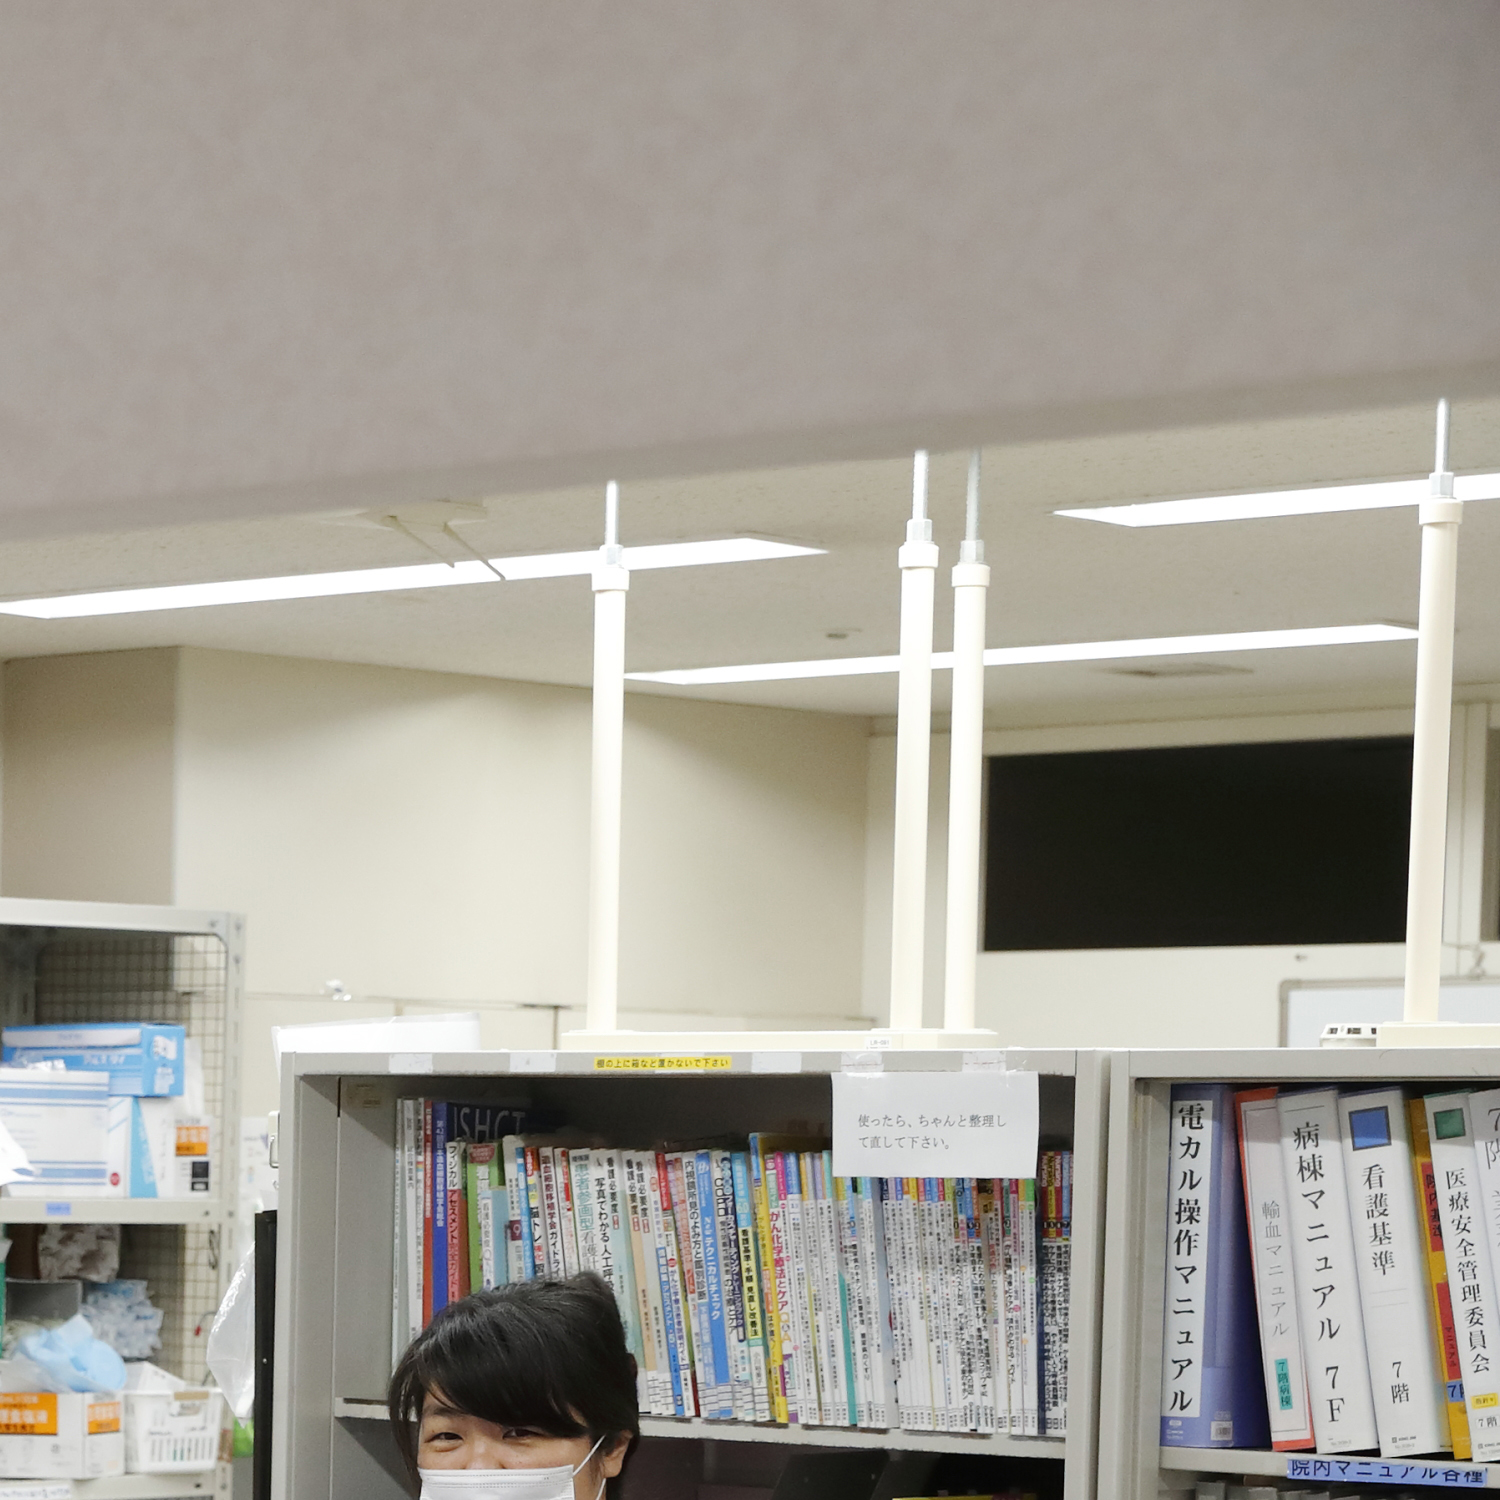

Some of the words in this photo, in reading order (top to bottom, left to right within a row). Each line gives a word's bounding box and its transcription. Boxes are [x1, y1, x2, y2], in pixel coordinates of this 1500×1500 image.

[858, 1113, 1007, 1129] 使ったら、ちゃんと整理し
[858, 1135, 951, 1150] て直して下さい。
[1169, 1102, 1206, 1413] 電カル操作マニュアル
[1261, 1200, 1290, 1338] 輸血マニュアル
[1292, 1121, 1341, 1343] 病棟マニュアル
[1325, 1366, 1346, 1424] 7F
[1361, 1164, 1396, 1278] 看護基準
[1390, 1361, 1410, 1404] 7階
[1445, 1167, 1490, 1375] 医療安全管理委員会
[1291, 1459, 1484, 1484] 院内マニュアル各種
[1478, 1415, 1498, 1429] 7階
